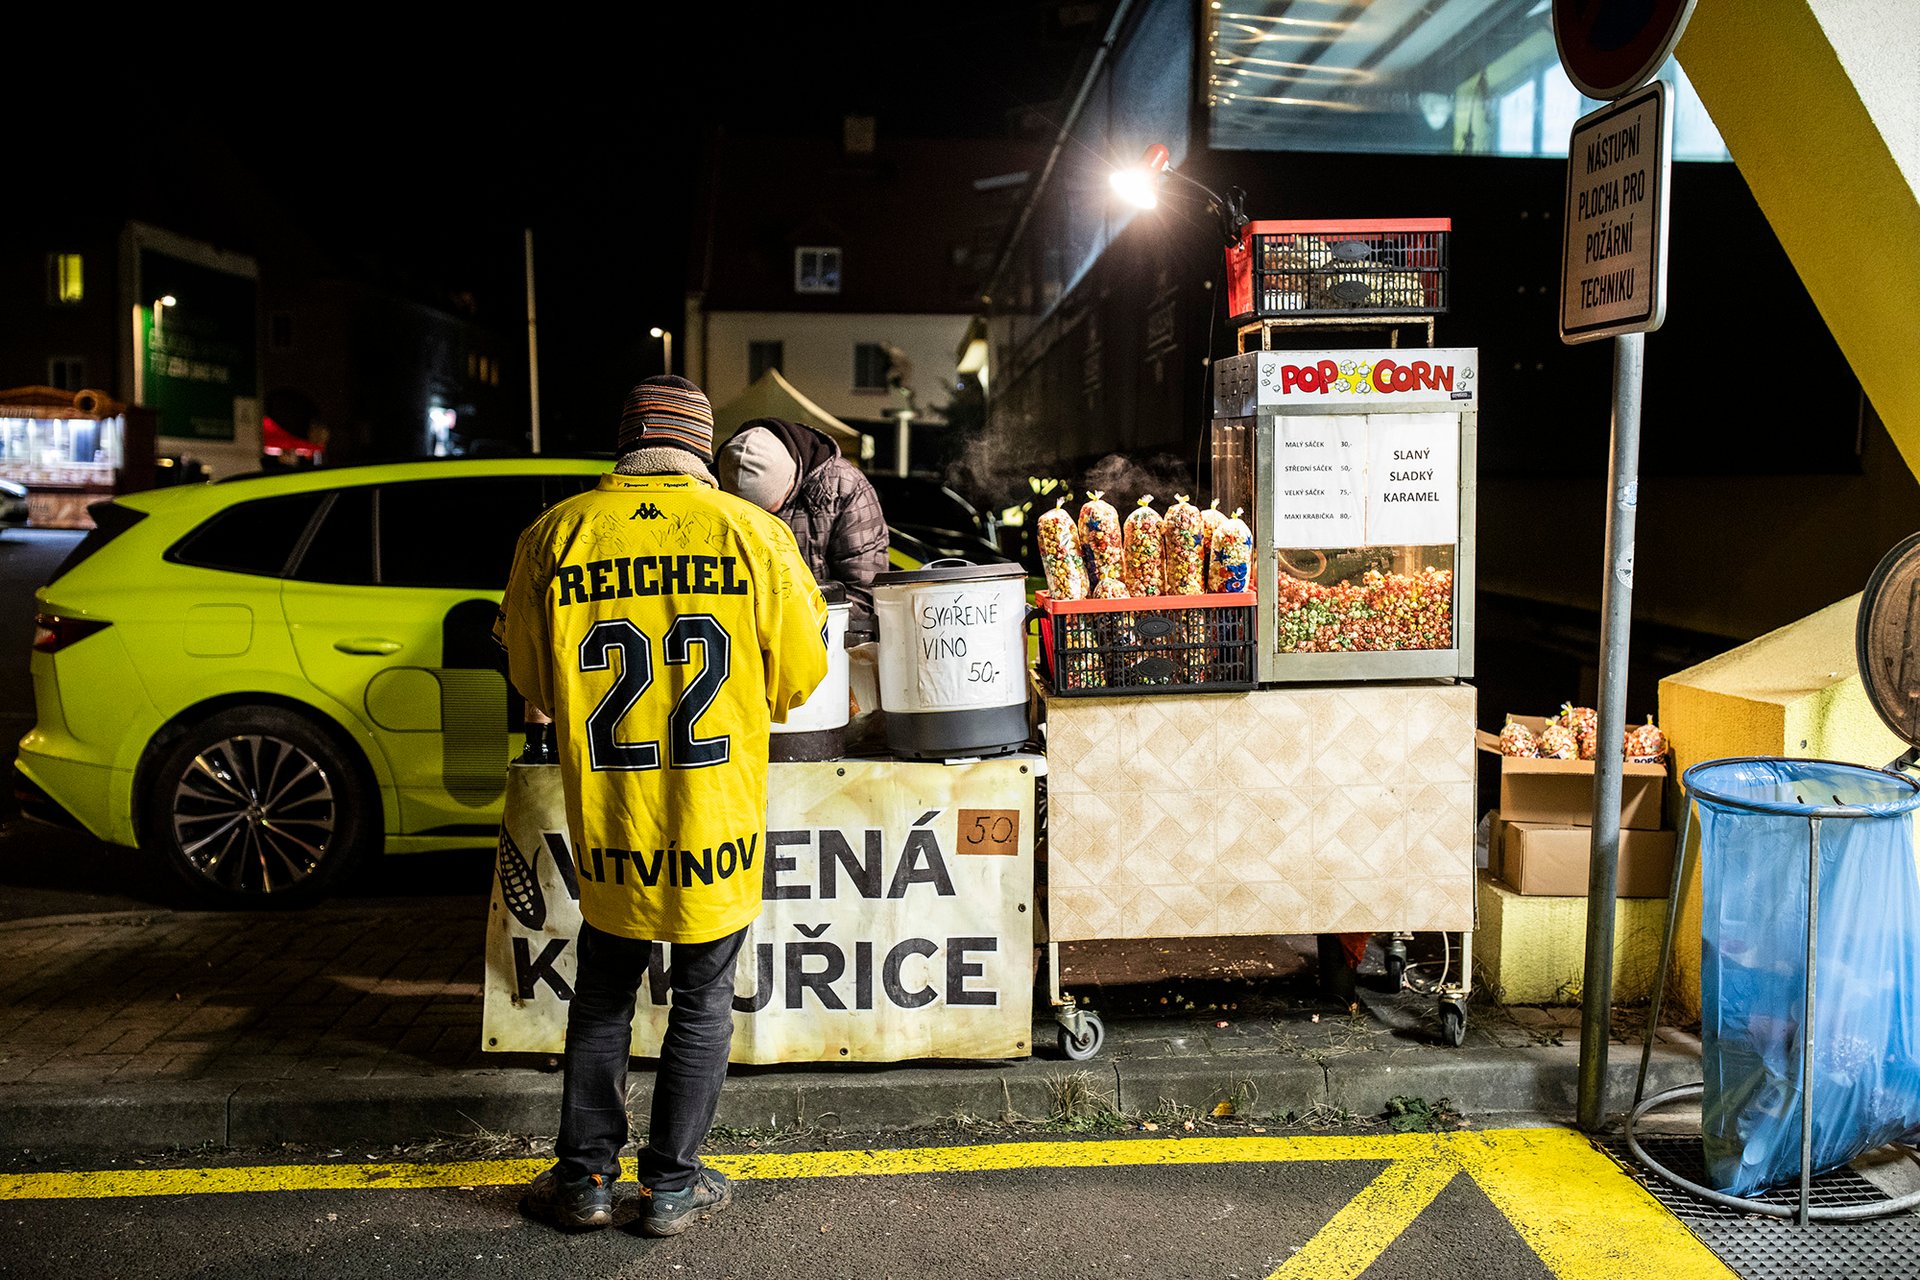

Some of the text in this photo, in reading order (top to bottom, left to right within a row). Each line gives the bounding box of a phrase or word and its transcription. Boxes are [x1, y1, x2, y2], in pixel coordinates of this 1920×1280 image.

[1586, 114, 1642, 175] NÁSTUPNÍ
[1578, 168, 1645, 222] PLOCHA PRO
[1585, 212, 1635, 264] POŽÁRNÍ
[1580, 267, 1635, 310] TECHNIKU
[1281, 358, 1455, 395] POP CORN
[1284, 440, 1353, 448] MALÝ SÁČEK 30,-
[1393, 447, 1431, 460] SLANÝ
[1284, 464, 1353, 472] STŘEDNÍ SÁČEK 50,-
[1389, 467, 1434, 481] SLADKÝ
[1284, 488, 1352, 496] VELKÝ SÁČEK 75,-
[1383, 491, 1440, 503] KARAMEL
[1302, 512, 1334, 520] KRABIČKA
[1339, 512, 1352, 520] 80,-
[555, 555, 748, 607] REICHEL
[921, 593, 1000, 630] SVAŘENÉ
[922, 630, 967, 660] VÍNO
[967, 661, 1000, 684] 50,-
[578, 613, 732, 772] 22
[575, 832, 758, 888] LITVÍNOV
[512, 922, 998, 1013] KUŘICE
